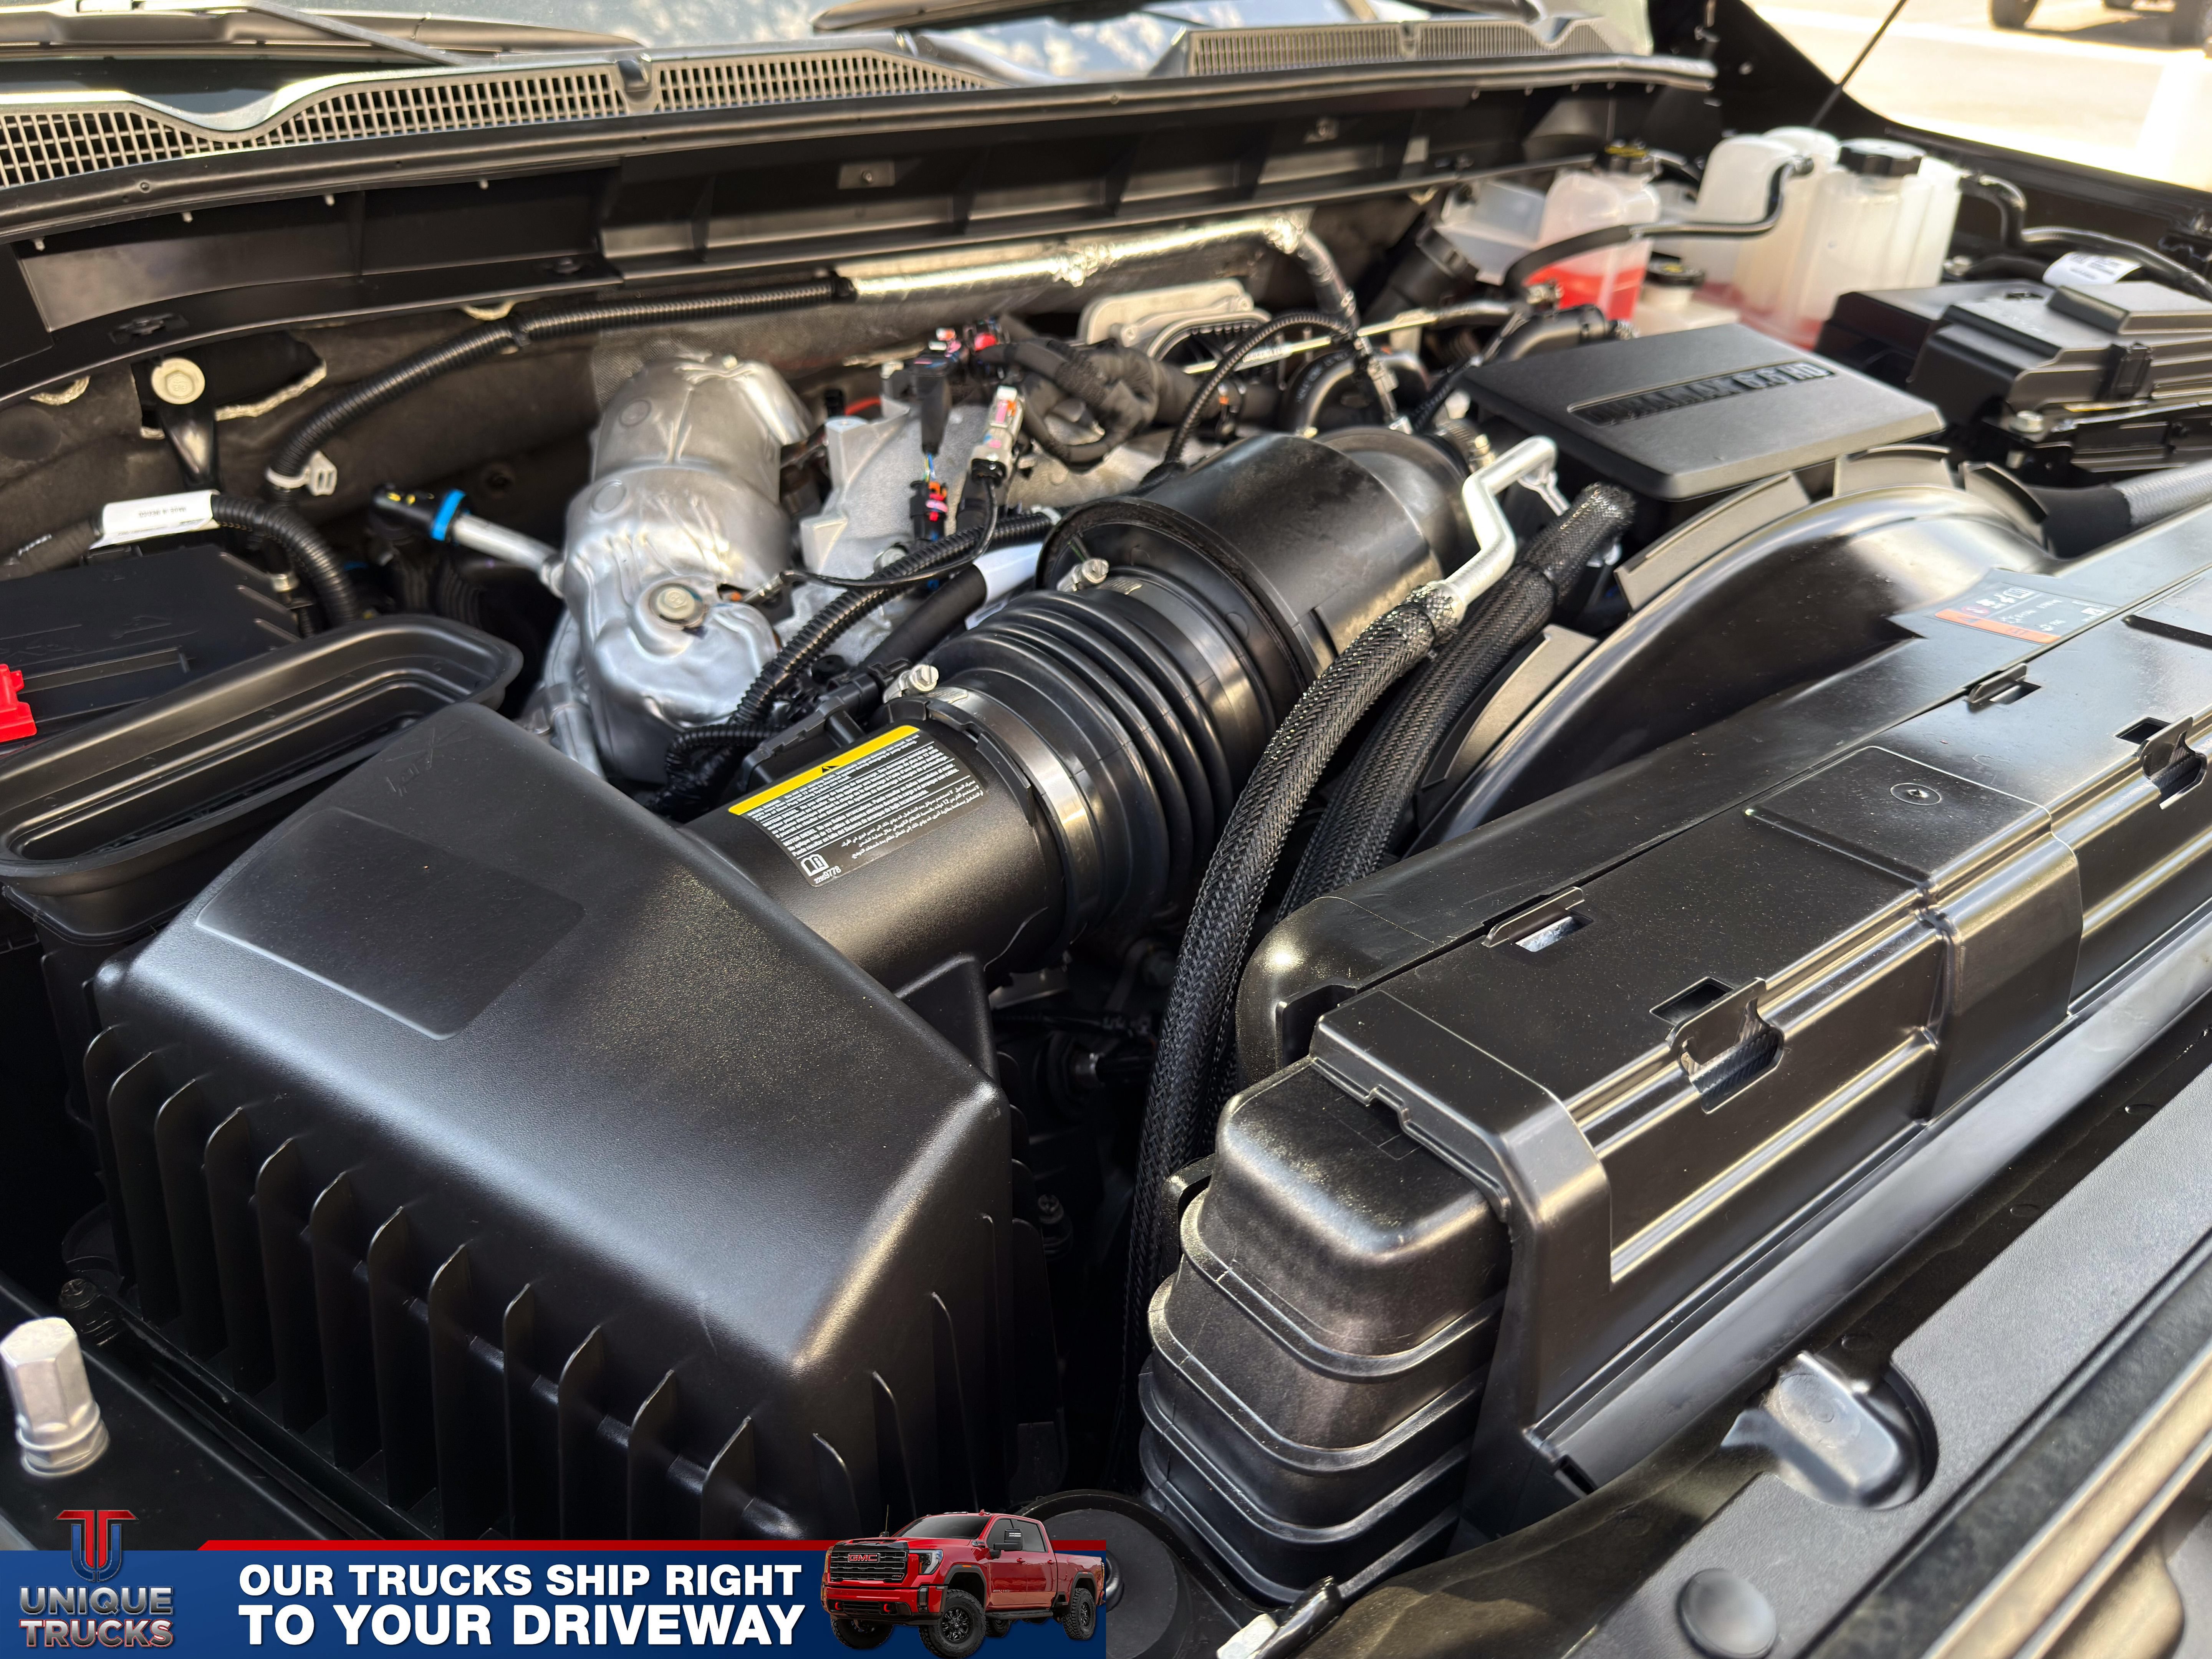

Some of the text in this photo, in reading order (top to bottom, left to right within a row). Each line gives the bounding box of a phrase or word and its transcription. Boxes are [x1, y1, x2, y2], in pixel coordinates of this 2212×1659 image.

[783, 836, 801, 846] MOTOR
[800, 829, 817, 839] DIESEL
[831, 815, 846, 823] fluidos
[846, 803, 874, 817] arrancadores.
[872, 796, 886, 804] Puede
[885, 789, 901, 798] resultar
[917, 772, 939, 783] inmediatos
[792, 848, 807, 856] Puede
[806, 840, 823, 850] resultar
[844, 821, 862, 832] Sistema
[867, 810, 885, 821] arranque
[795, 839, 811, 848] aplique
[831, 822, 846, 830] voltios
[849, 812, 867, 822] sistema
[866, 804, 884, 814] eléctrico
[883, 797, 899, 806] durante
[921, 778, 938, 788] arranque
[945, 768, 959, 777] cables.
